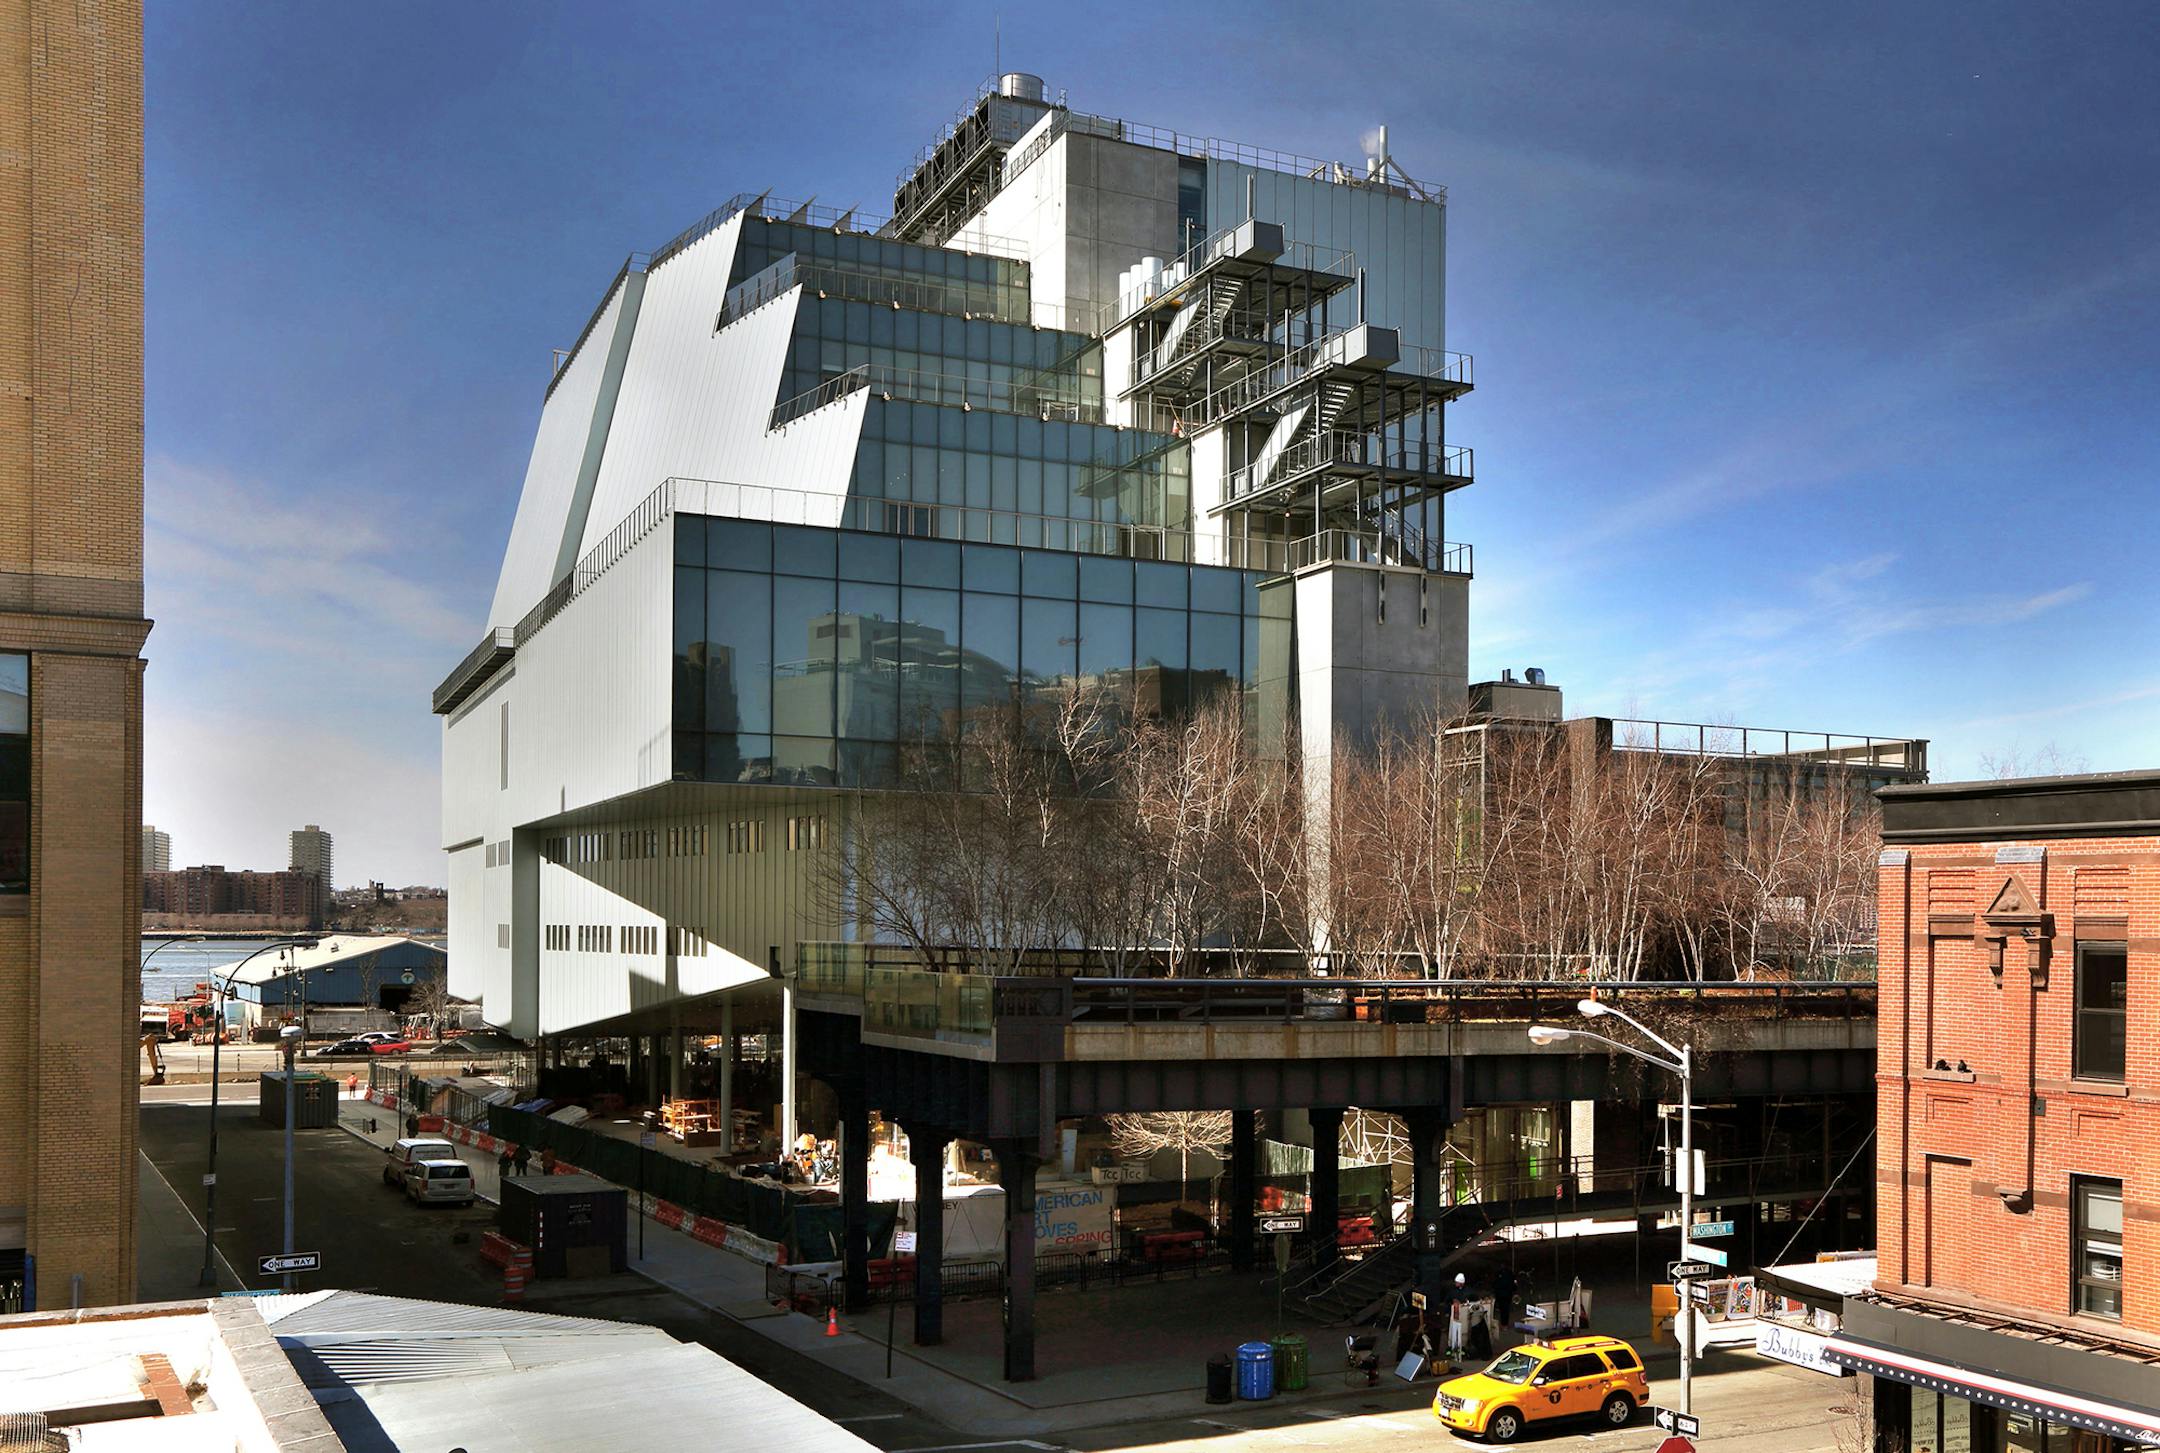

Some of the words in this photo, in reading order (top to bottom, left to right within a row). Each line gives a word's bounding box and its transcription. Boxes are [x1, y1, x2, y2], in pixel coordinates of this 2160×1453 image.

[1102, 1169, 1118, 1180] TCC
[1693, 1224, 1726, 1236] WASHINGTON
[268, 1260, 284, 1269] ONE
[293, 1258, 311, 1266] WAY
[1693, 1264, 1706, 1272] WAY
